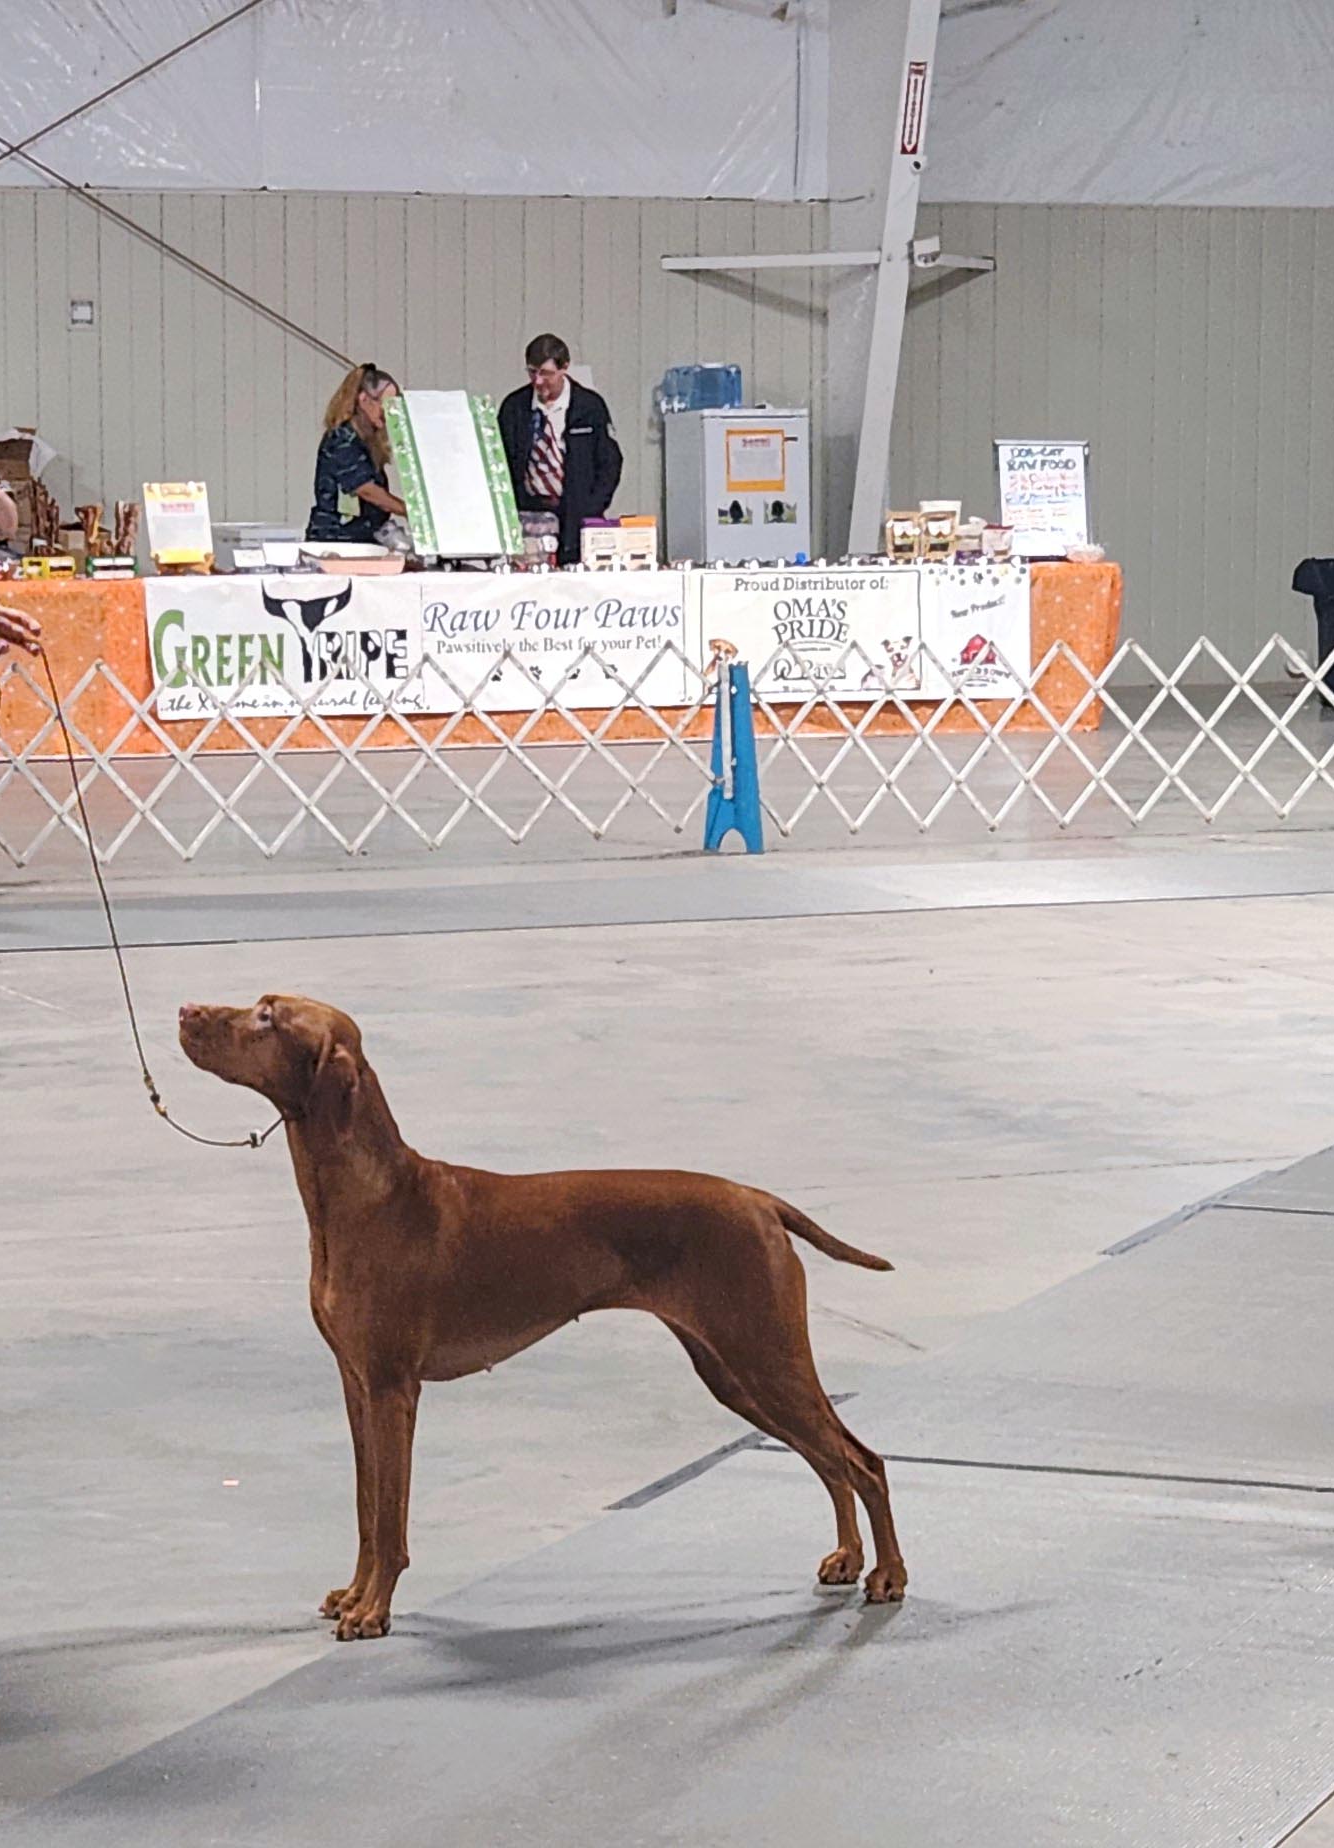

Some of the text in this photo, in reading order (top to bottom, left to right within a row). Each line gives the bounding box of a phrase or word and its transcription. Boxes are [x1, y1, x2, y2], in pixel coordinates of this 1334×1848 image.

[1040, 458, 1077, 471] FOOD
[734, 577, 779, 592] Proud
[783, 577, 866, 591] Distributor
[424, 598, 682, 639] Raw Four Paws
[773, 597, 848, 621] OMA'S
[771, 619, 850, 645] PRIDE
[153, 609, 285, 689] GREEN
[437, 634, 661, 654] Pawsitively the Best for your Pet!
[288, 690, 358, 708] nural
